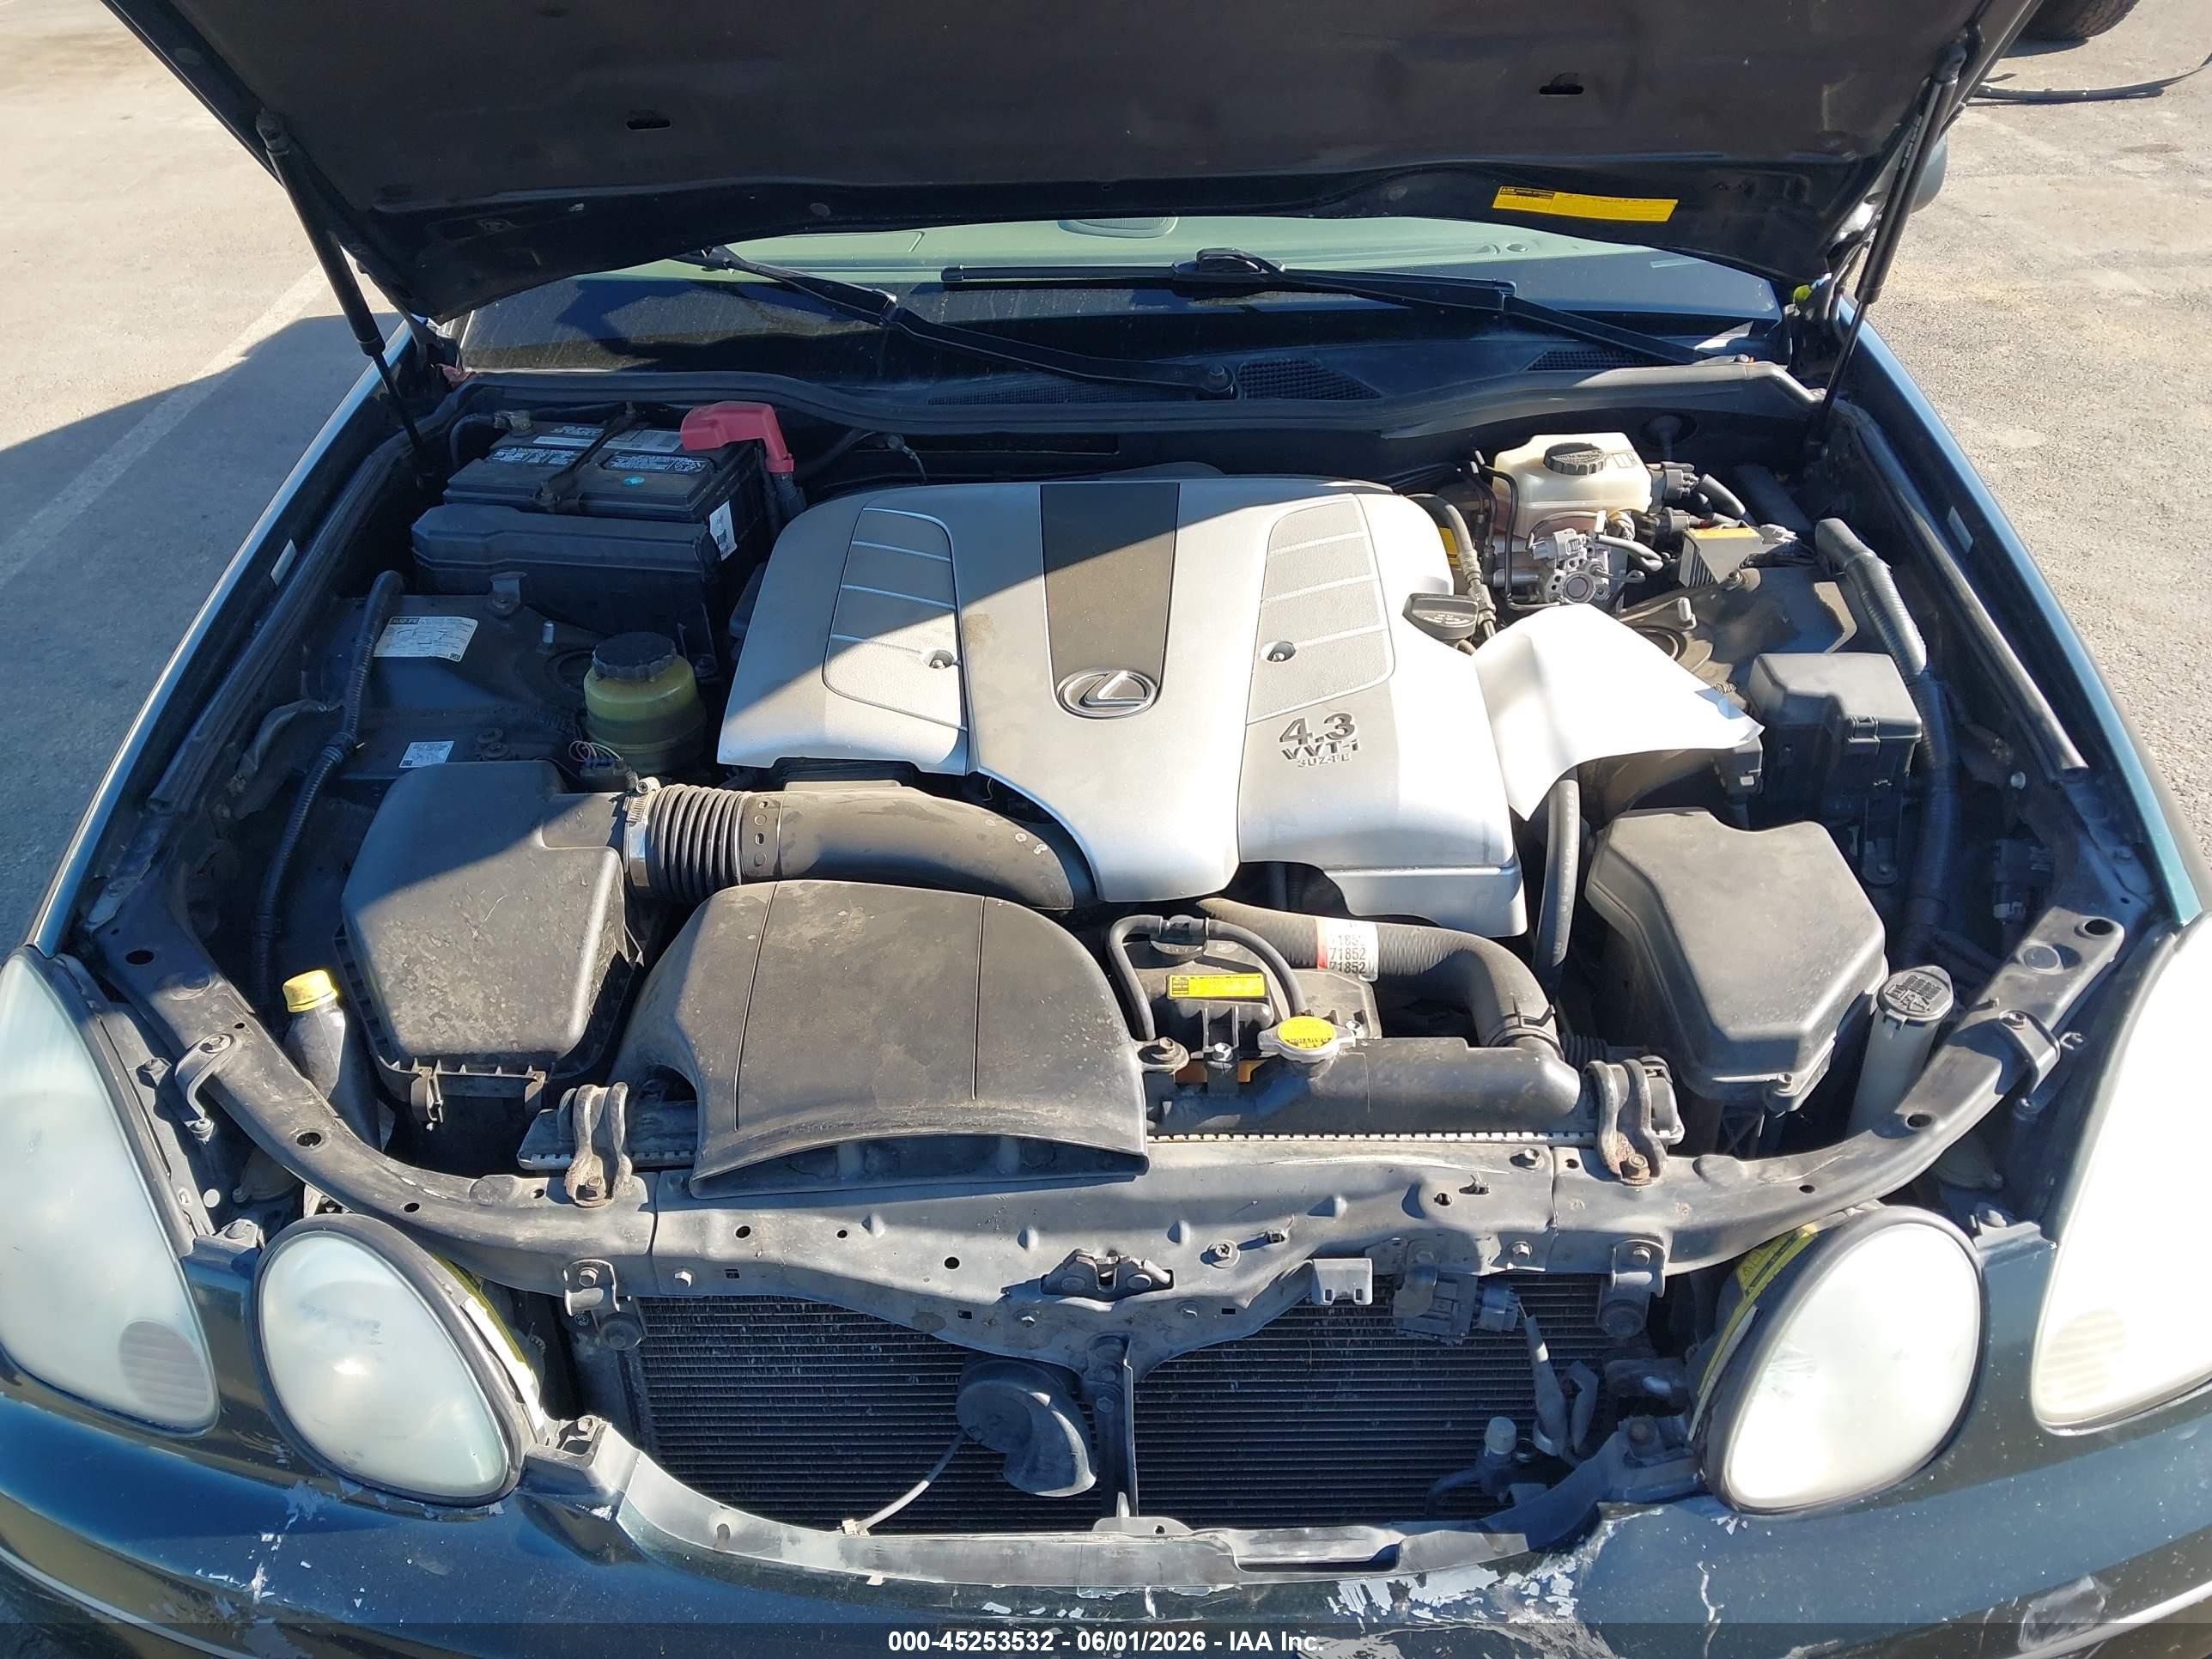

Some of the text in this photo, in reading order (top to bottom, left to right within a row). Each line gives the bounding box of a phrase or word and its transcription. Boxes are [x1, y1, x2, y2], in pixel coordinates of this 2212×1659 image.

[1279, 713, 1356, 744] 4.3
[1281, 739, 1358, 760] VVT-i
[1329, 947, 1366, 961] 71852
[1329, 961, 1366, 975] 71852
